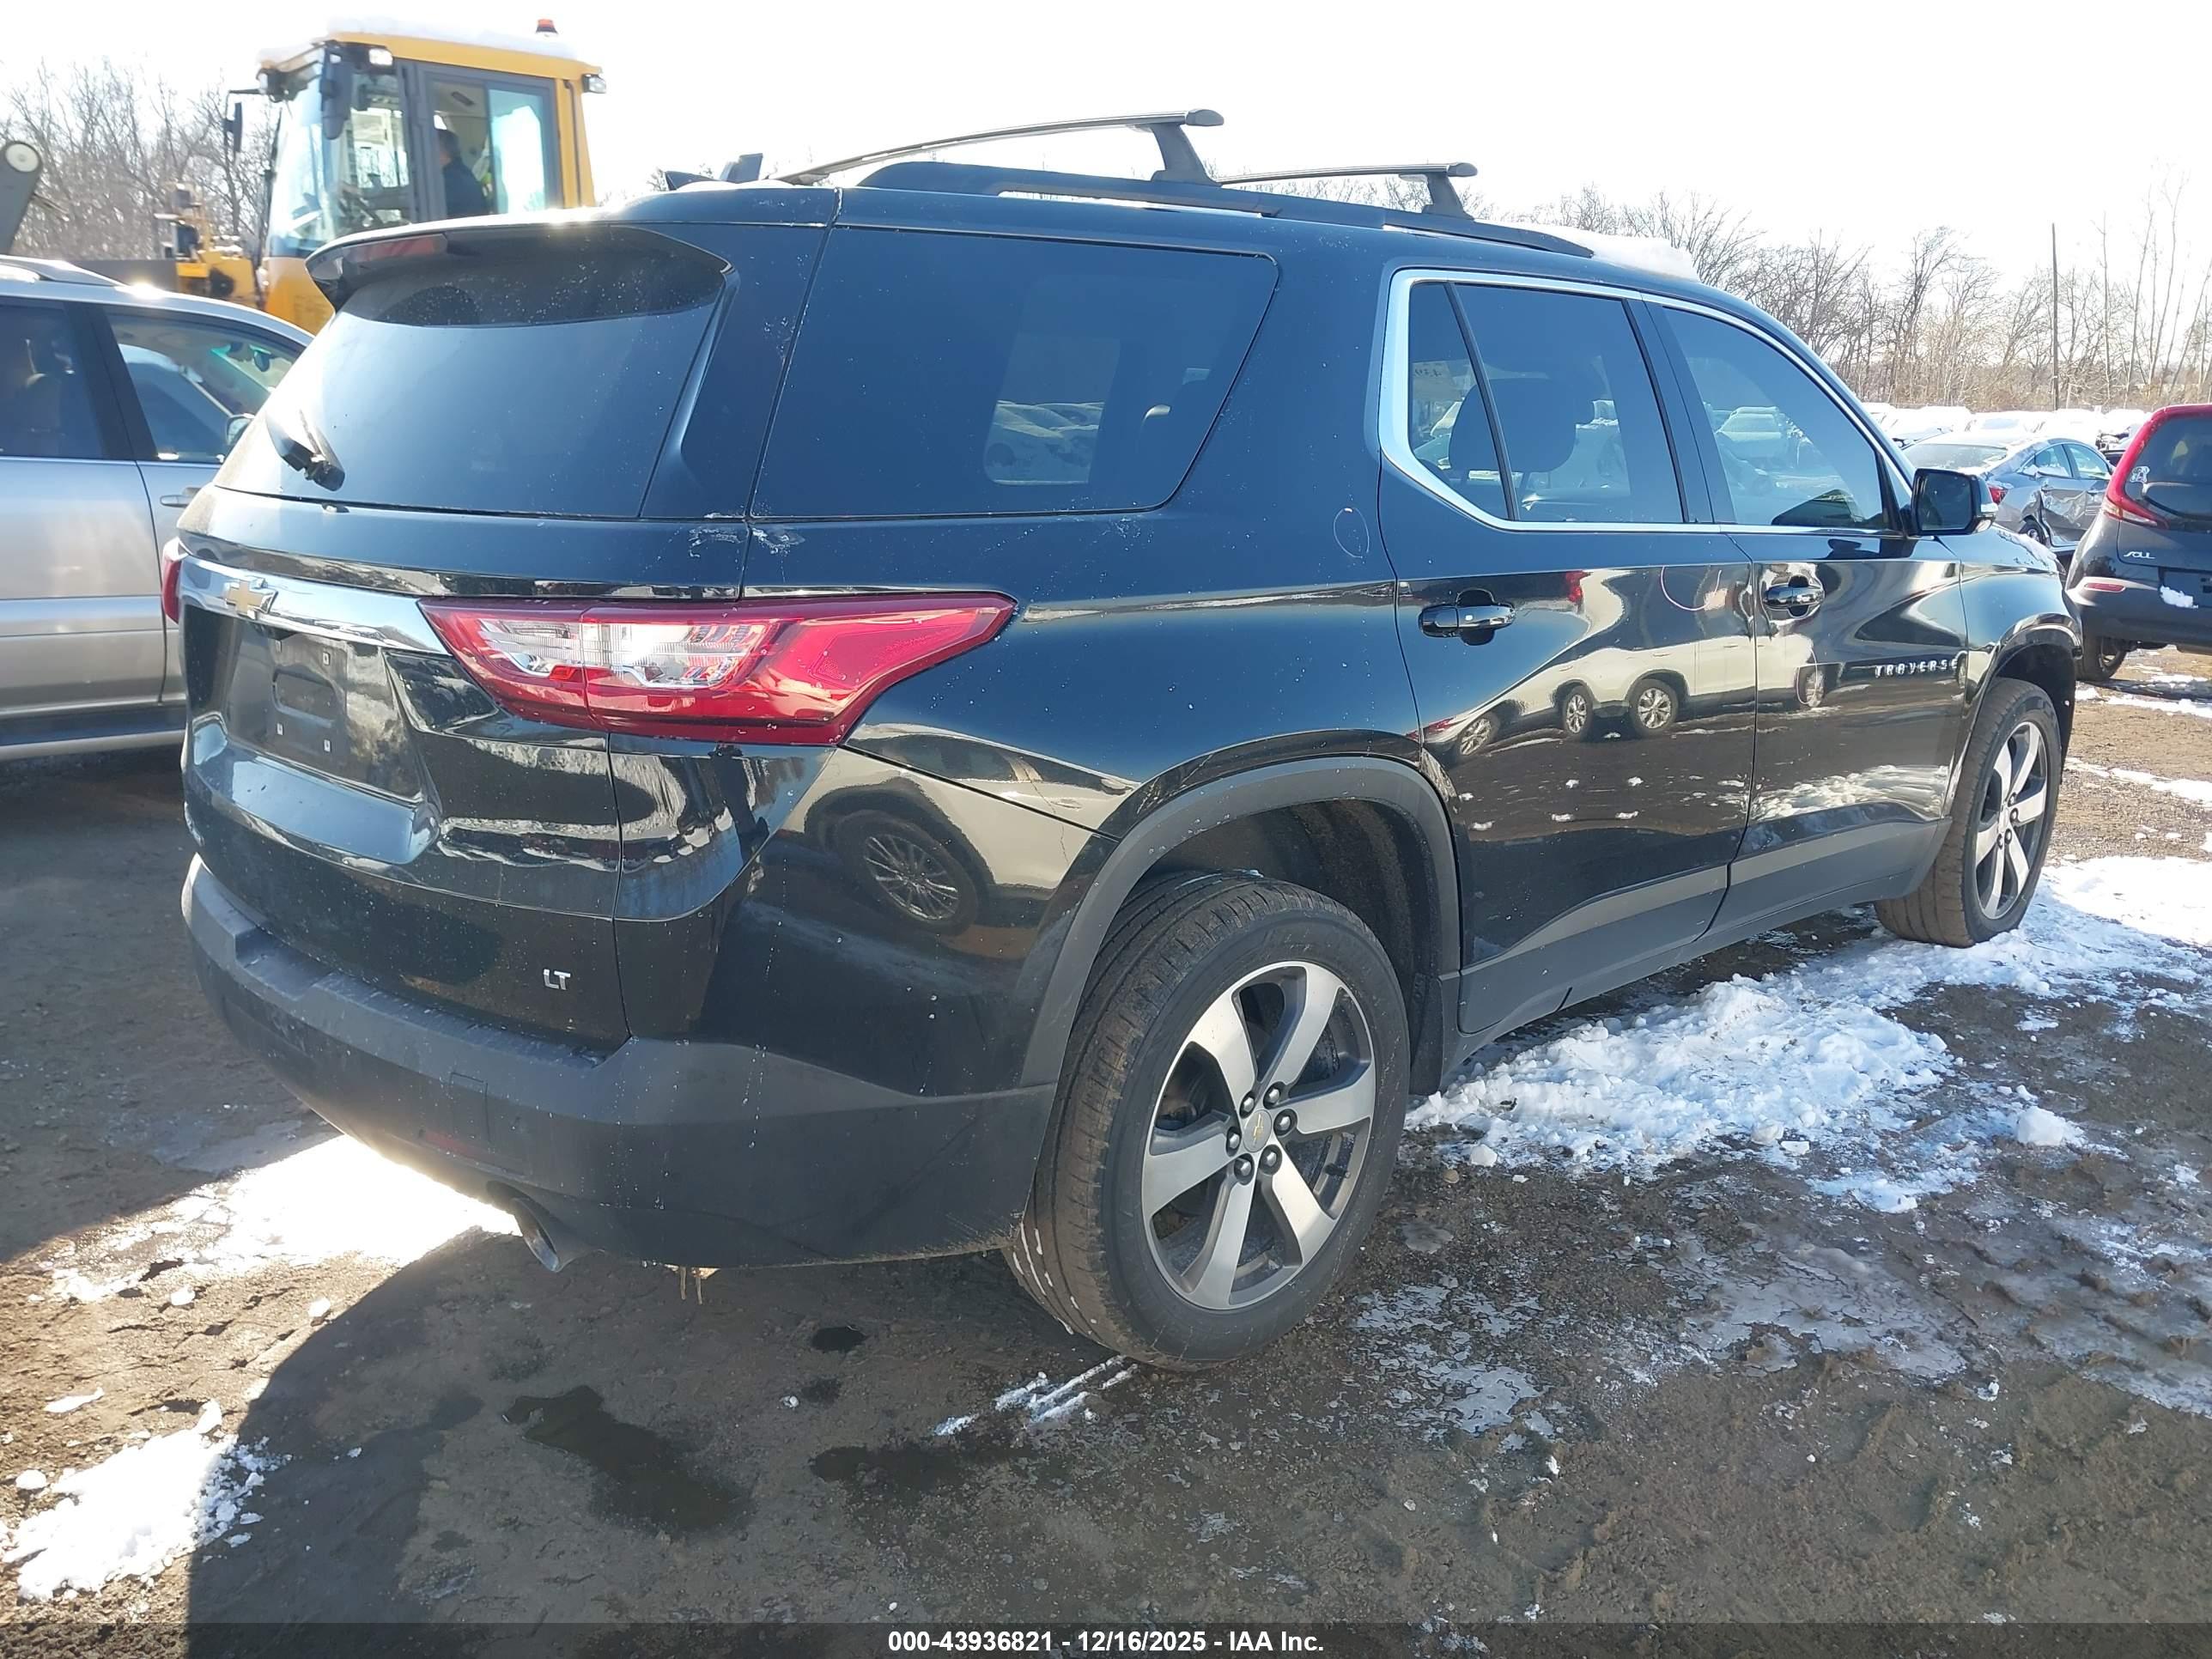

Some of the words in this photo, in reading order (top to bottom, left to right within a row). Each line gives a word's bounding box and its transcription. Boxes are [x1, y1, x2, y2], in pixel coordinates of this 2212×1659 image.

[2124, 550, 2155, 559] SOUL
[1875, 659, 1958, 678] TRAVERSE
[543, 968, 571, 991] LT
